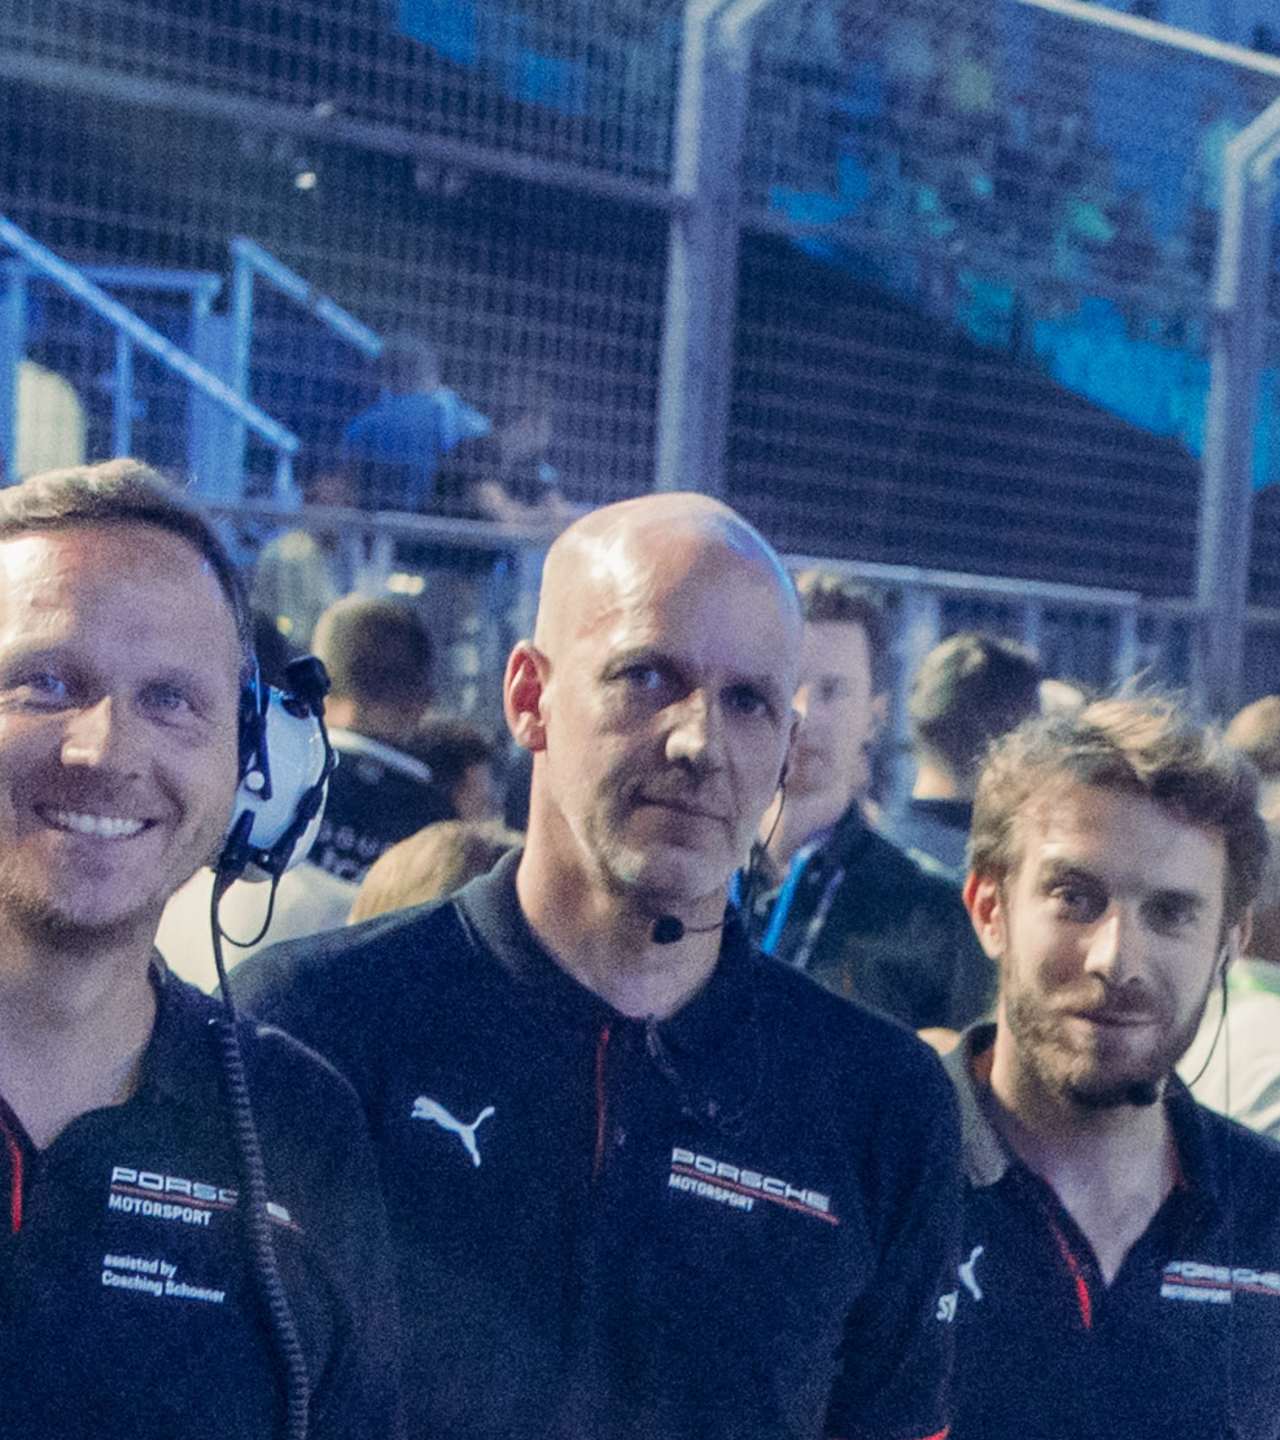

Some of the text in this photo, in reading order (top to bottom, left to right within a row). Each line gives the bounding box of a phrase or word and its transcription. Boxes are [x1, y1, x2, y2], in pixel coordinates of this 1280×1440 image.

[668, 1173, 754, 1212] MOTORSPORT
[672, 1148, 832, 1211] PORSCHE
[108, 1194, 212, 1226] MOTORSPORT
[104, 1254, 178, 1278] assisted by
[102, 1270, 163, 1297] Coaching
